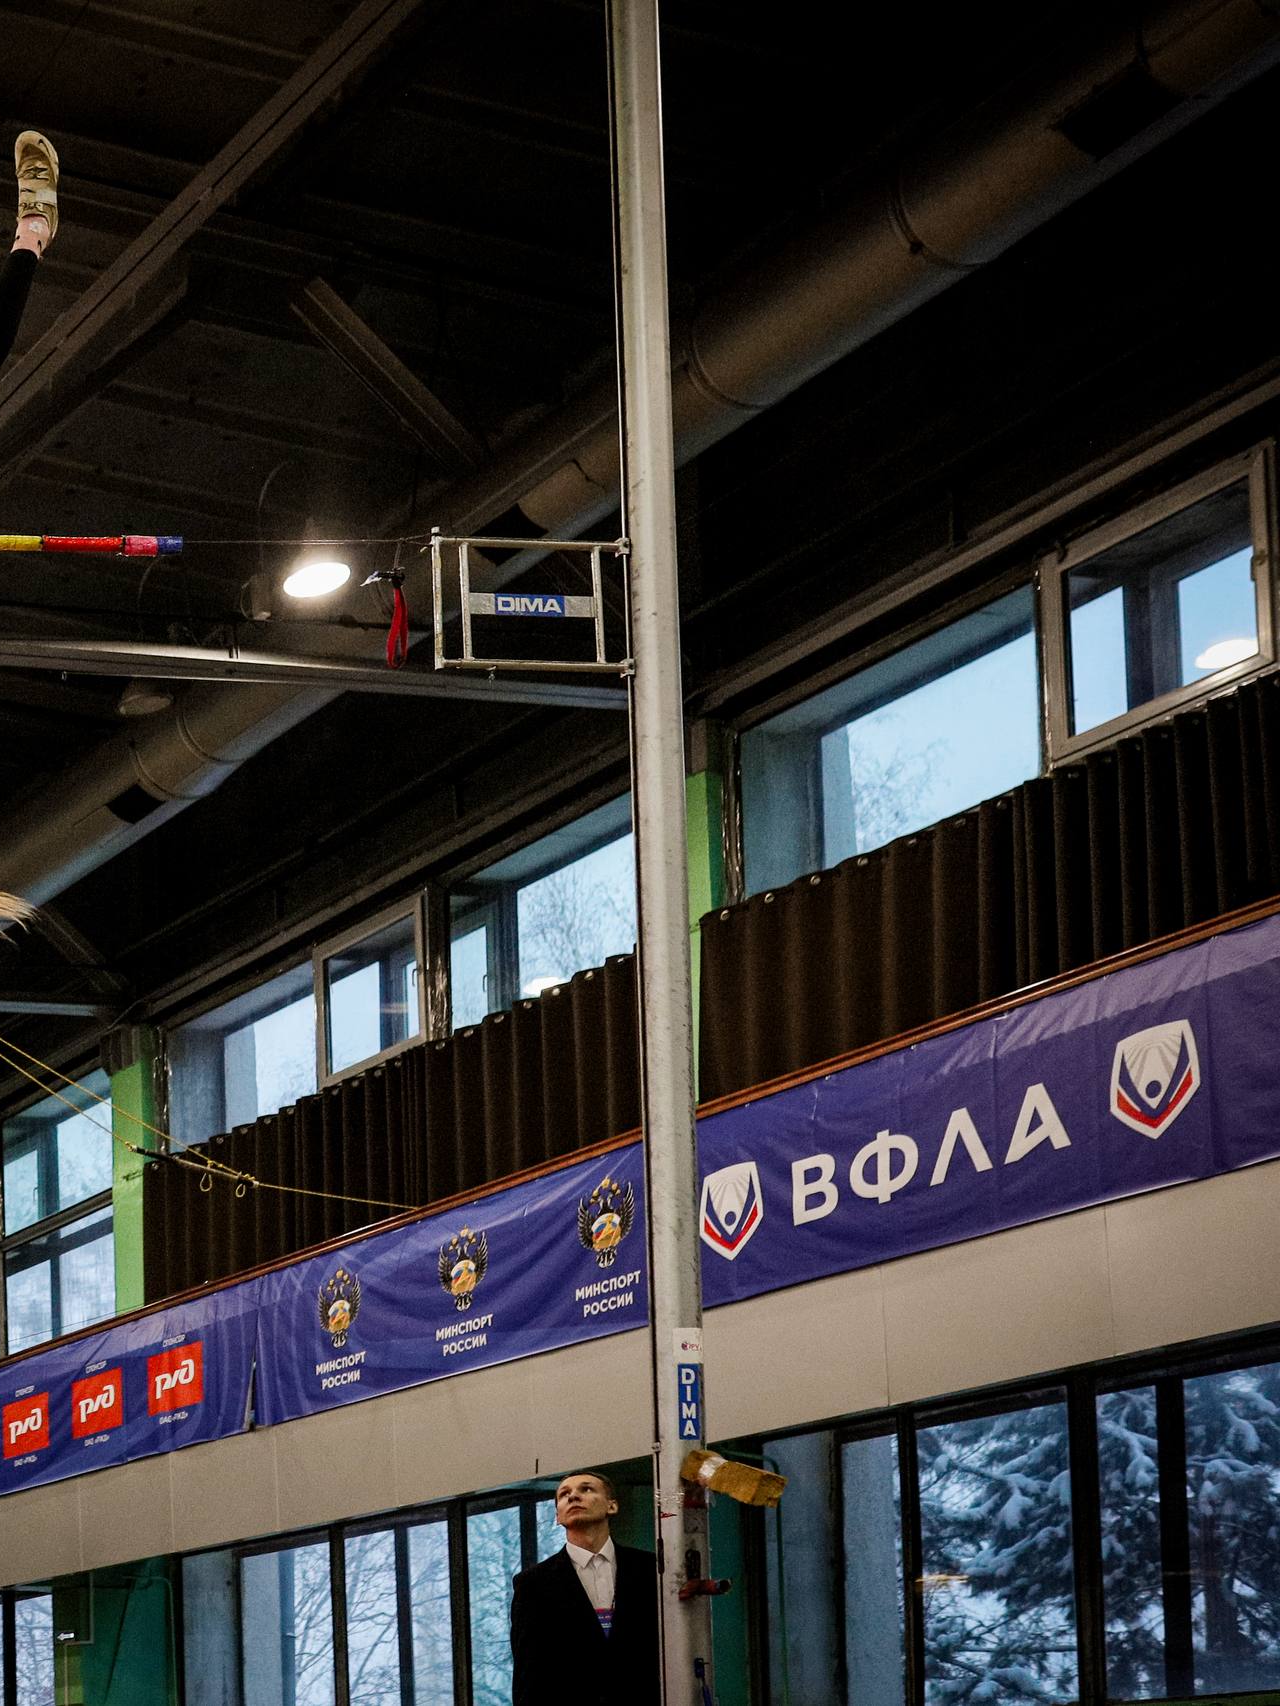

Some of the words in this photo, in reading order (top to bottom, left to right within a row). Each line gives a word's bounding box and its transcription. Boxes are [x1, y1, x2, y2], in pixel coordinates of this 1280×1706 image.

[497, 597, 562, 613] DIMA
[792, 1082, 1071, 1226] ВФЛА
[576, 1270, 641, 1301] МИНСПОРТ
[584, 1291, 634, 1318] РОССИИ
[436, 1313, 493, 1341] МИНСПОРТ
[443, 1333, 487, 1357] РОССИИ
[316, 1351, 366, 1375] МИНСПОРТ
[322, 1370, 360, 1390] РОССИИ
[681, 1368, 697, 1436] DIMA
